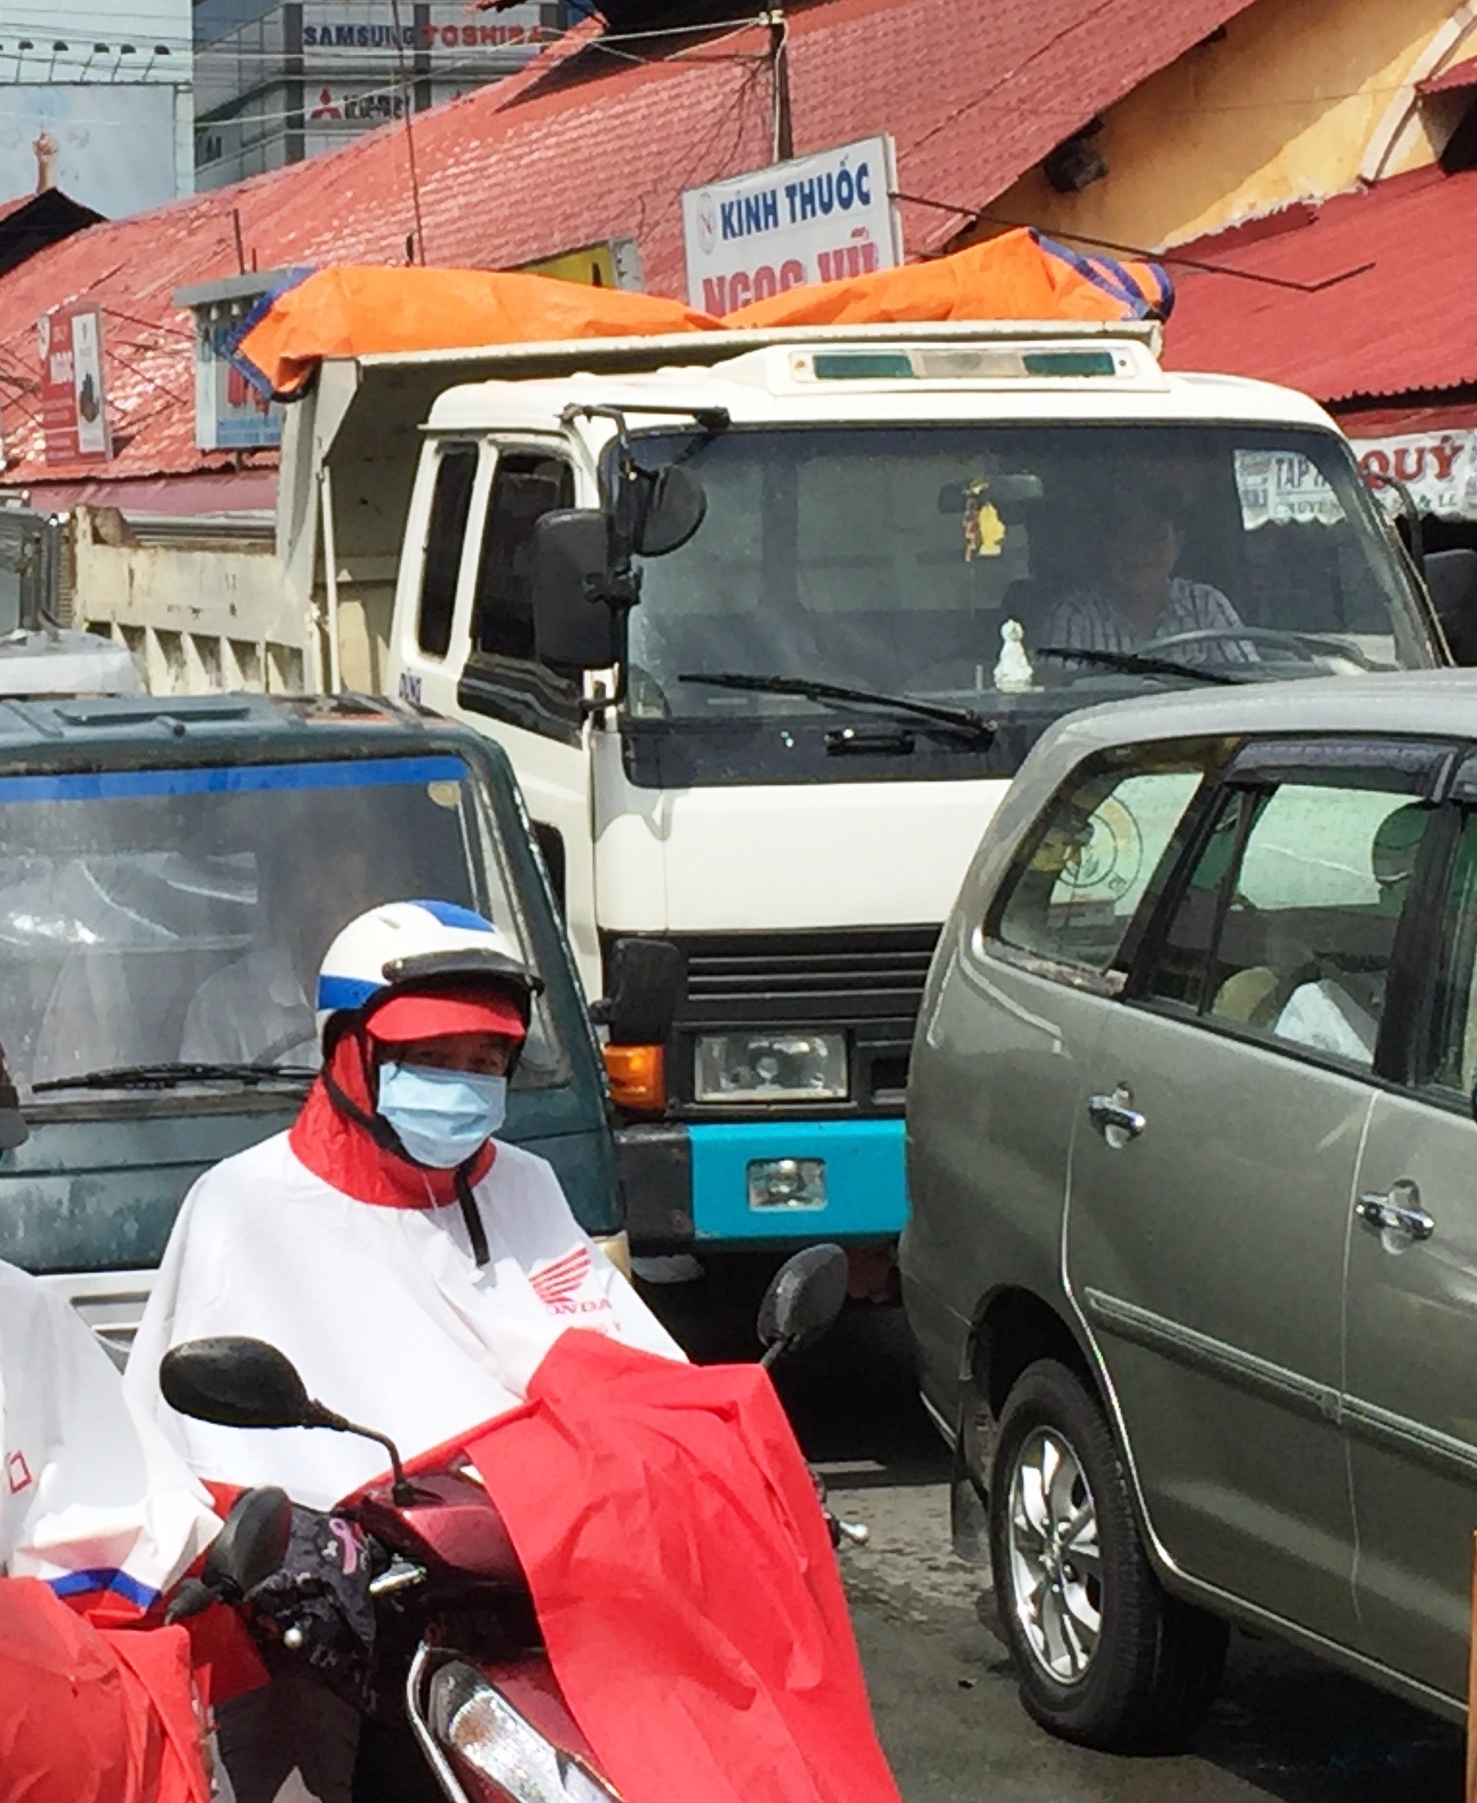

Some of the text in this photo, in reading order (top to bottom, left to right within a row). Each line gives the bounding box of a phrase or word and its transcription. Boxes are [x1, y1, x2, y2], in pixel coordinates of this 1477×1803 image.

[304, 25, 415, 47] SAMSUNG
[422, 23, 546, 47] TOSHIBA
[784, 153, 871, 224] THUỐC
